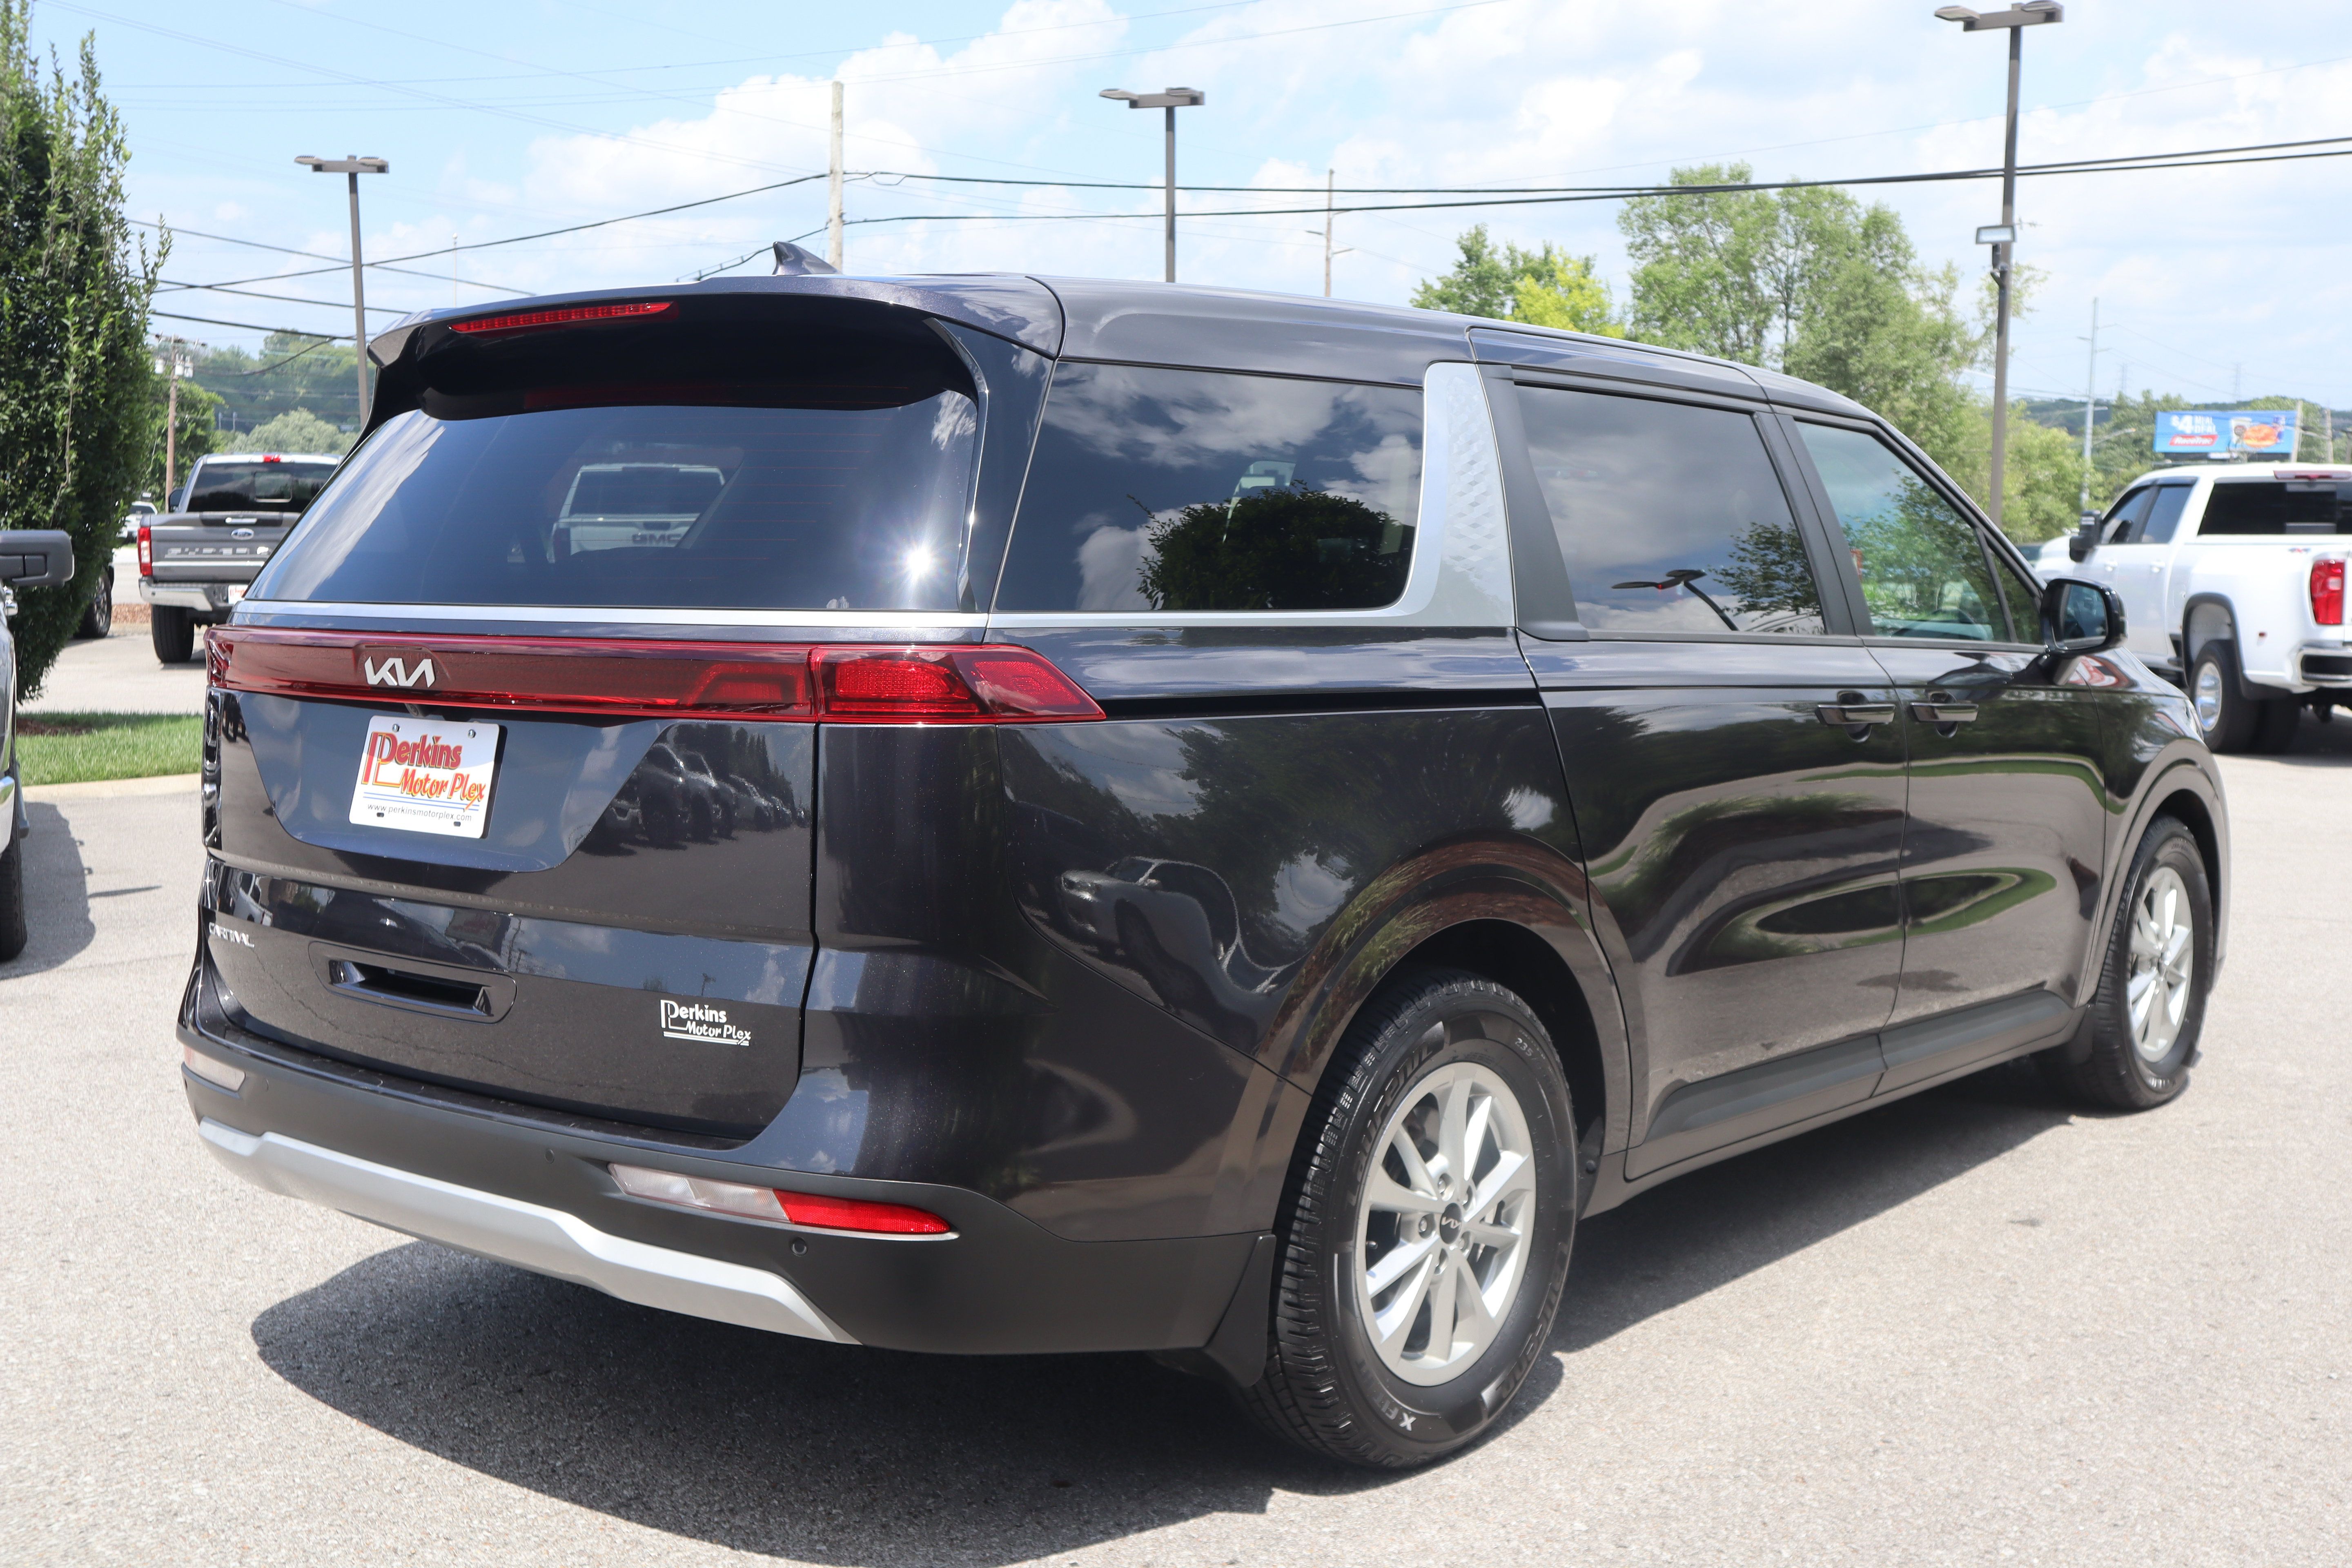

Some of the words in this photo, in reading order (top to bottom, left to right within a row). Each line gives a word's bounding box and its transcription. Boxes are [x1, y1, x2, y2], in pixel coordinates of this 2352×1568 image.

[2171, 415, 2193, 433] $4
[2194, 415, 2212, 424] MEAL
[2194, 425, 2216, 433] DEAL
[632, 534, 682, 544] GMC
[364, 656, 436, 688] KIA
[361, 731, 463, 785] Perkins
[401, 768, 449, 797] Motor
[448, 773, 486, 812] Plex
[368, 803, 472, 822] www.perkinsmotorplex.com
[660, 999, 727, 1029] Perkins
[686, 1020, 722, 1037] Motor
[723, 1024, 751, 1045] Plex
